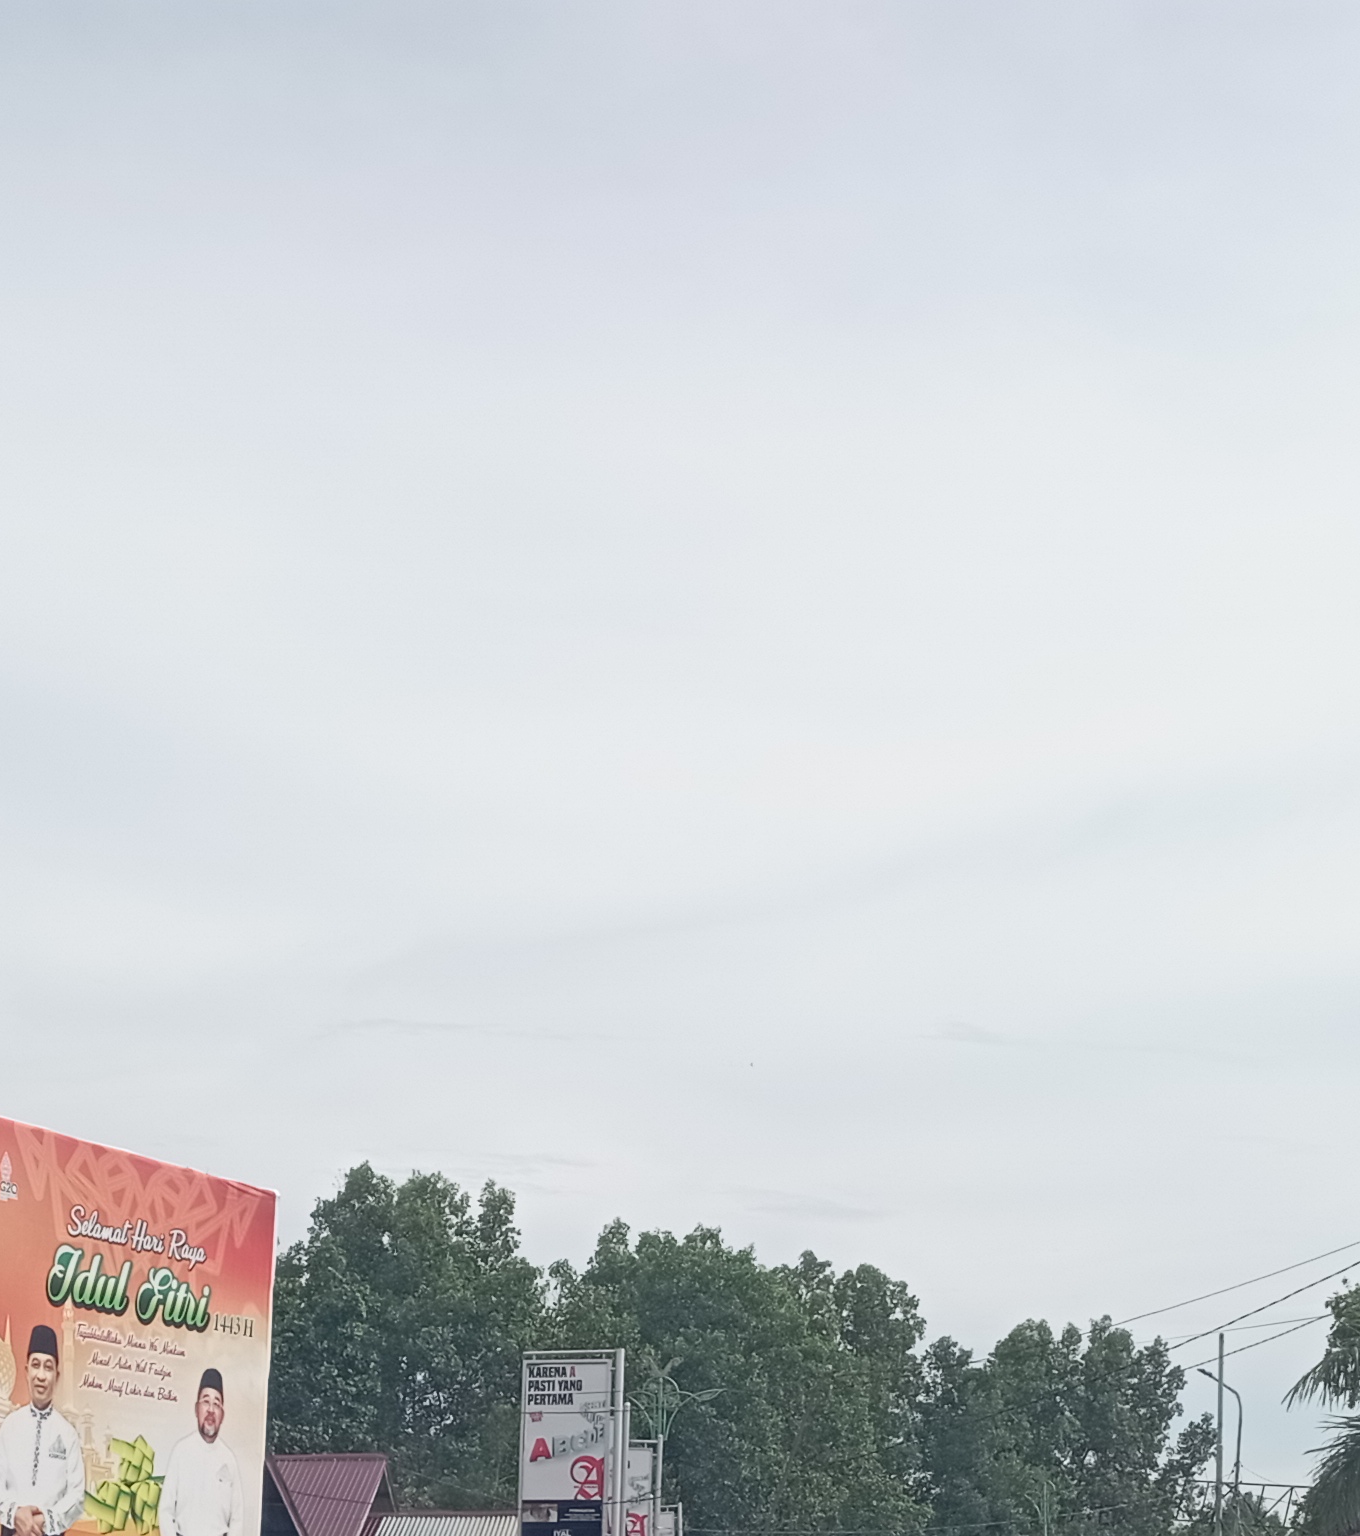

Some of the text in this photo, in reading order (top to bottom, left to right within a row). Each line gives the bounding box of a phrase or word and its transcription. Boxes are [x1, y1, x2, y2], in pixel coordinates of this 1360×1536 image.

[67, 1205, 207, 1271] Selamat Hari Raya
[47, 1244, 254, 1338] Idul Fitri 1443 H
[528, 1366, 576, 1378] KARENA A
[528, 1380, 556, 1392] PASTI
[528, 1393, 574, 1405] PERTAMA
